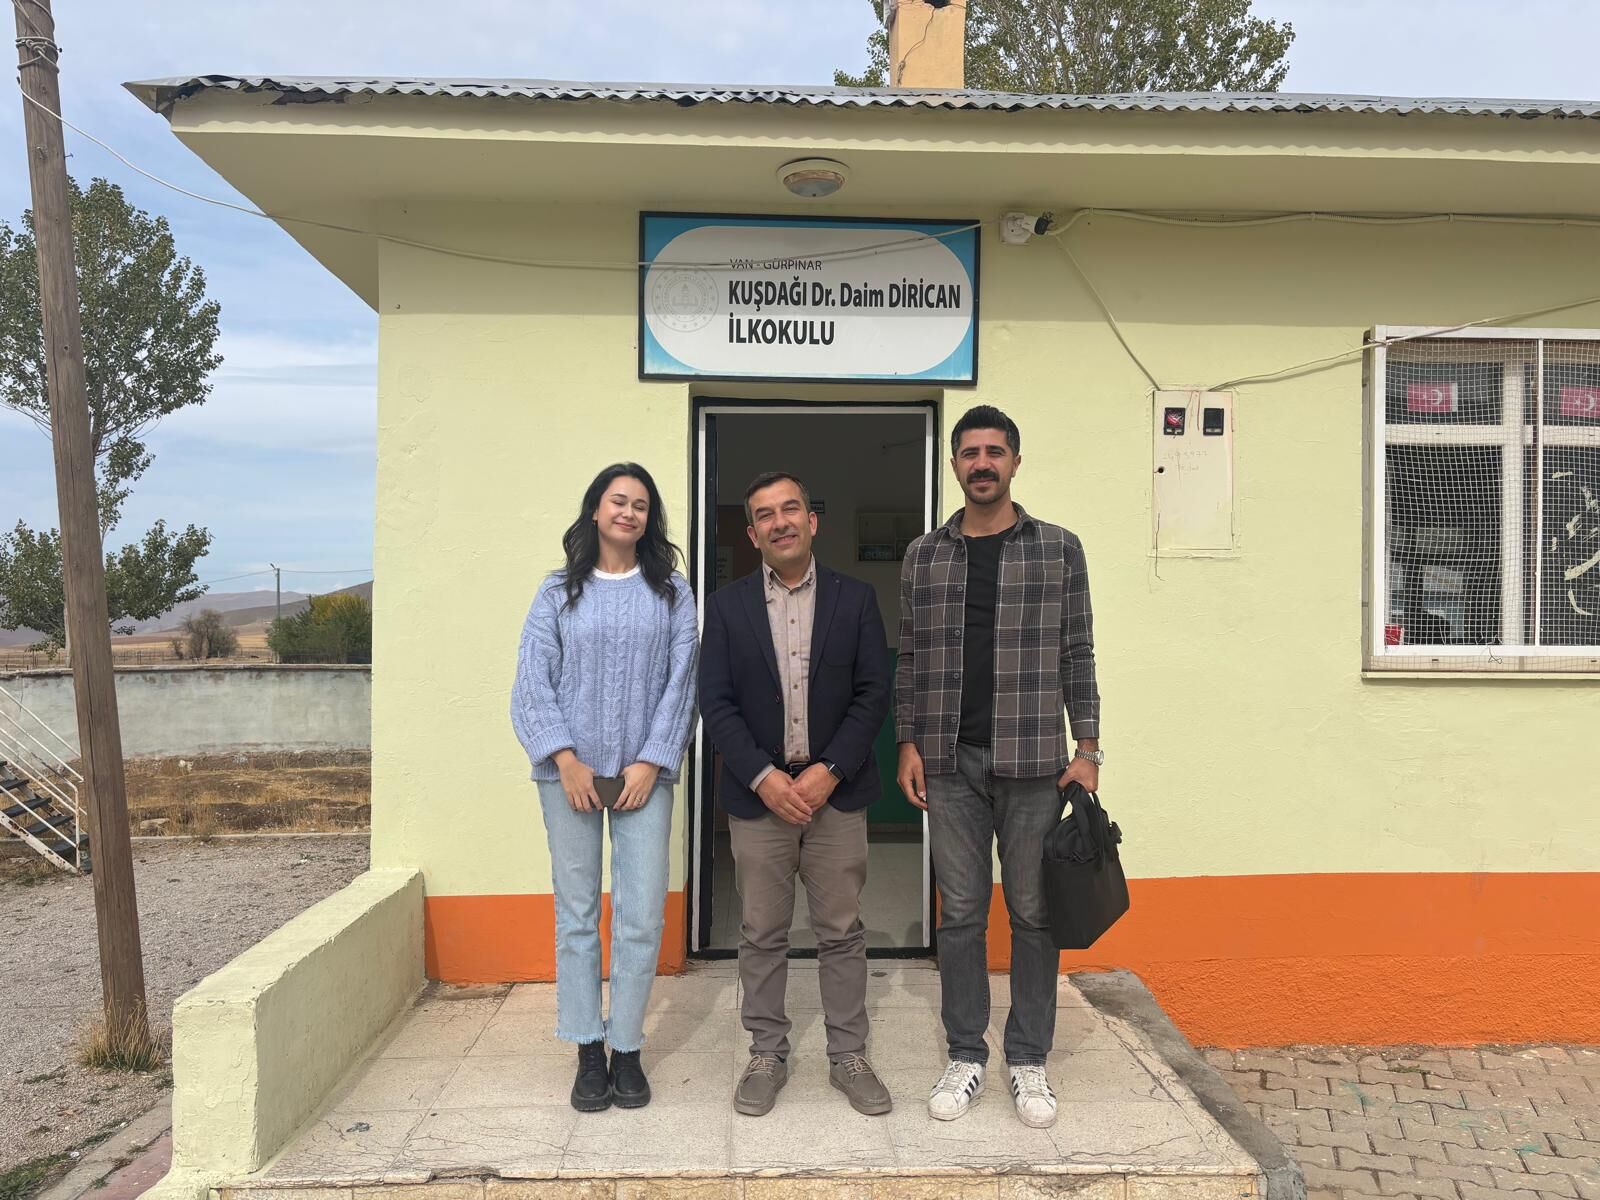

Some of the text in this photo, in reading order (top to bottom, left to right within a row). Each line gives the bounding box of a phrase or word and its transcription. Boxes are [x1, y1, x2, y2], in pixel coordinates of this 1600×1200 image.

[729, 258, 754, 270] VAN
[764, 258, 822, 270] GÜRPINAR
[728, 275, 807, 312] KUŞDAĞI
[811, 281, 836, 307] Dr.
[840, 282, 884, 308] Daim
[888, 277, 961, 309] DİRİCAN
[728, 312, 835, 346] İLKOKULU
